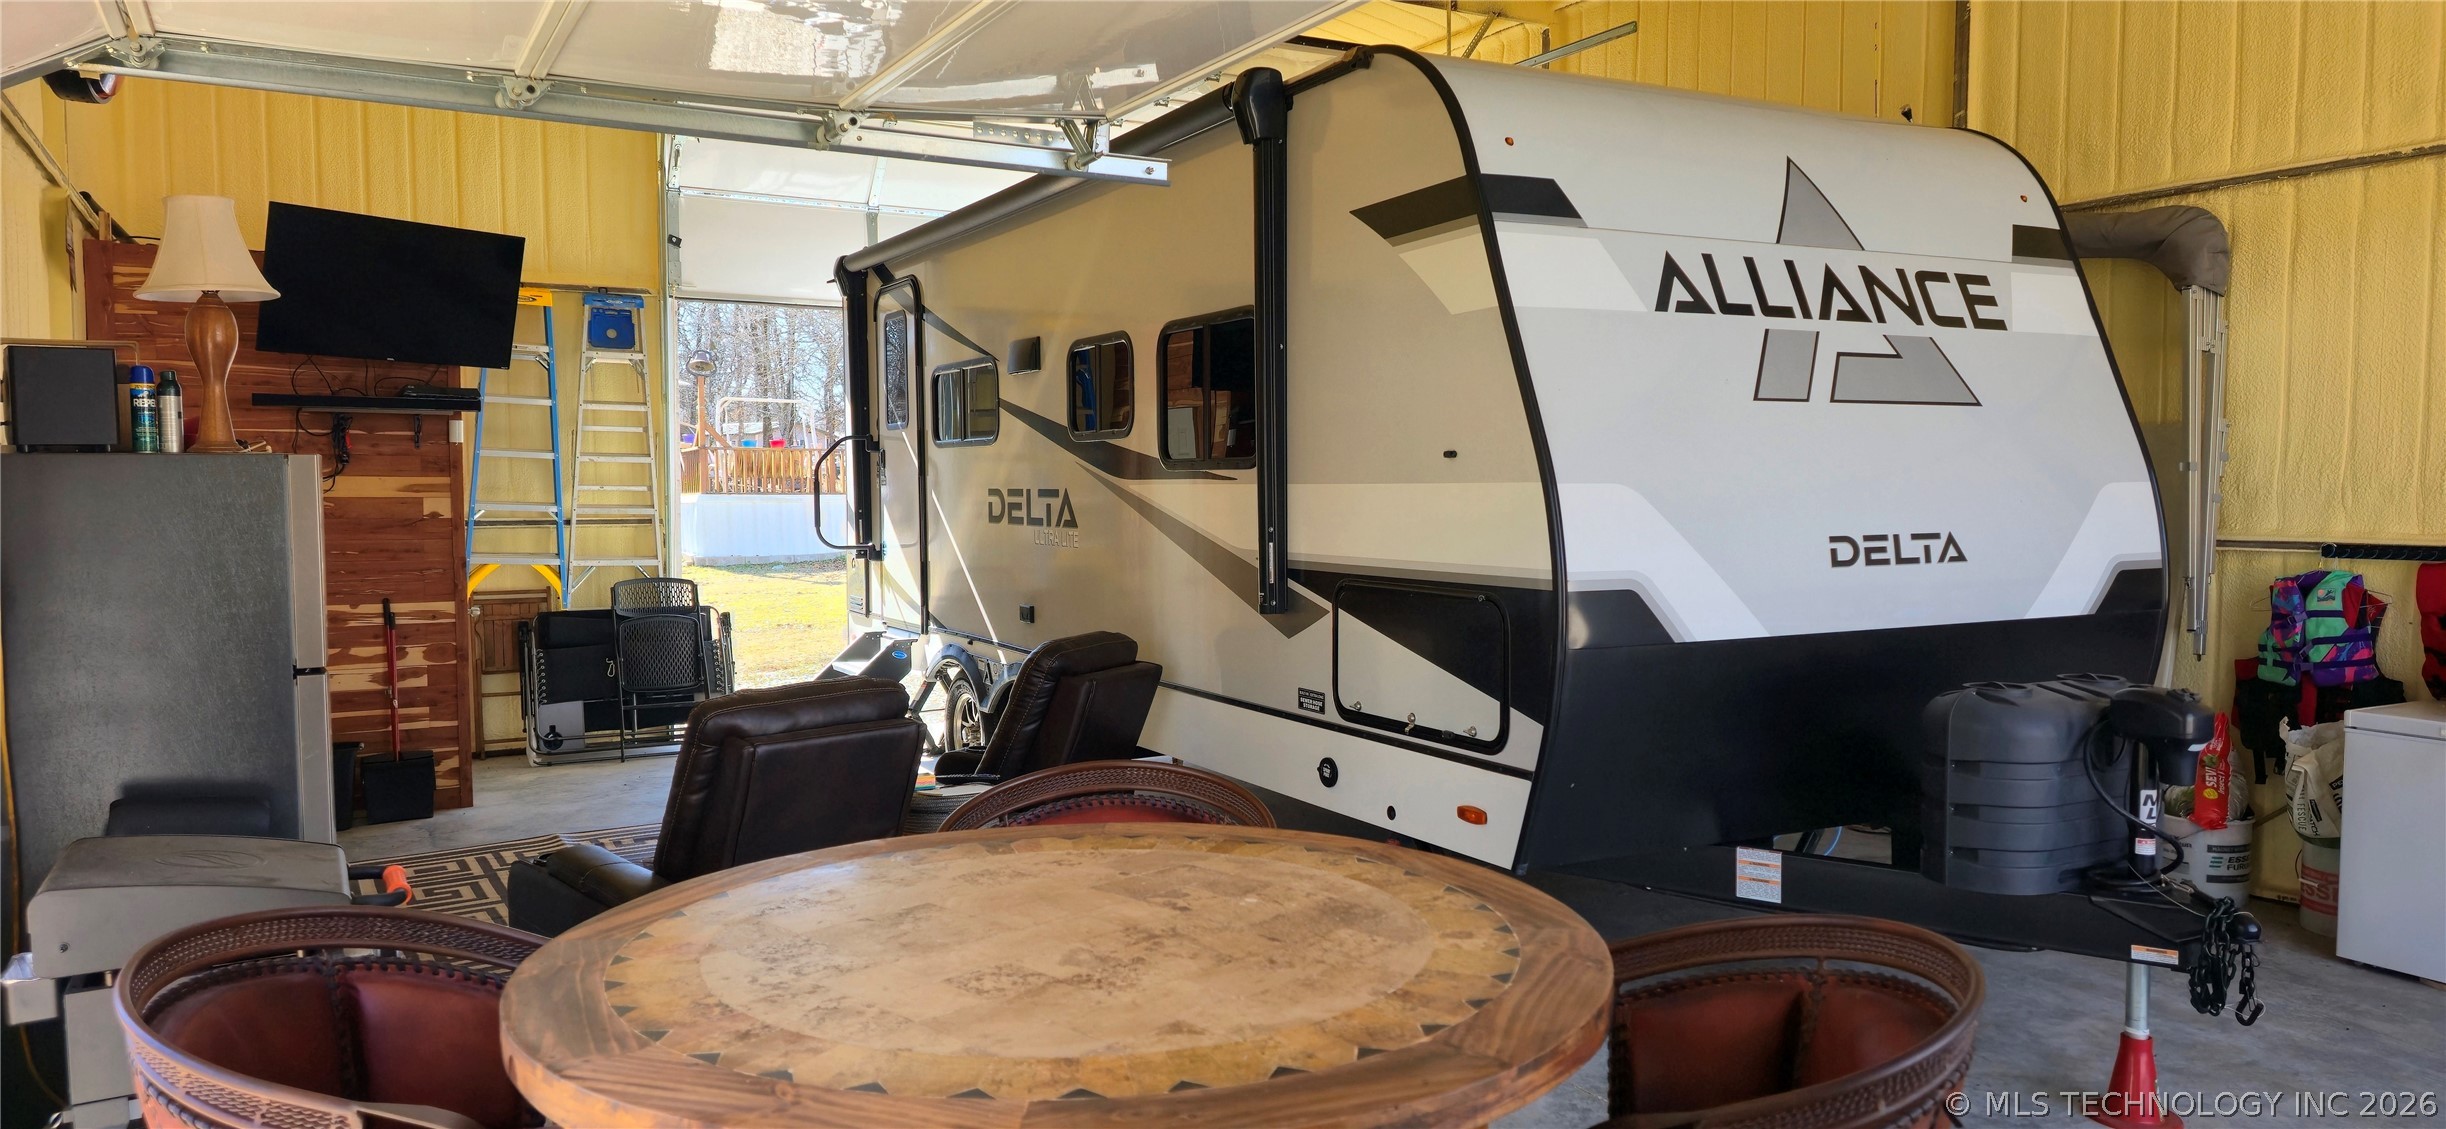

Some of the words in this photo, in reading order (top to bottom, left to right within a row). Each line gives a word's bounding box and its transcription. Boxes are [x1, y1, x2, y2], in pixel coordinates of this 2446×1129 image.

[1654, 250, 2008, 331] ALLIANCE
[133, 398, 156, 408] REPE
[988, 487, 1078, 528] DELTA
[1033, 529, 1060, 547] ULTRA
[1061, 531, 1079, 549] LITE
[1828, 531, 1968, 569] DELTA
[2205, 766, 2217, 788] SEVI
[2297, 803, 2307, 832] FESCUE
